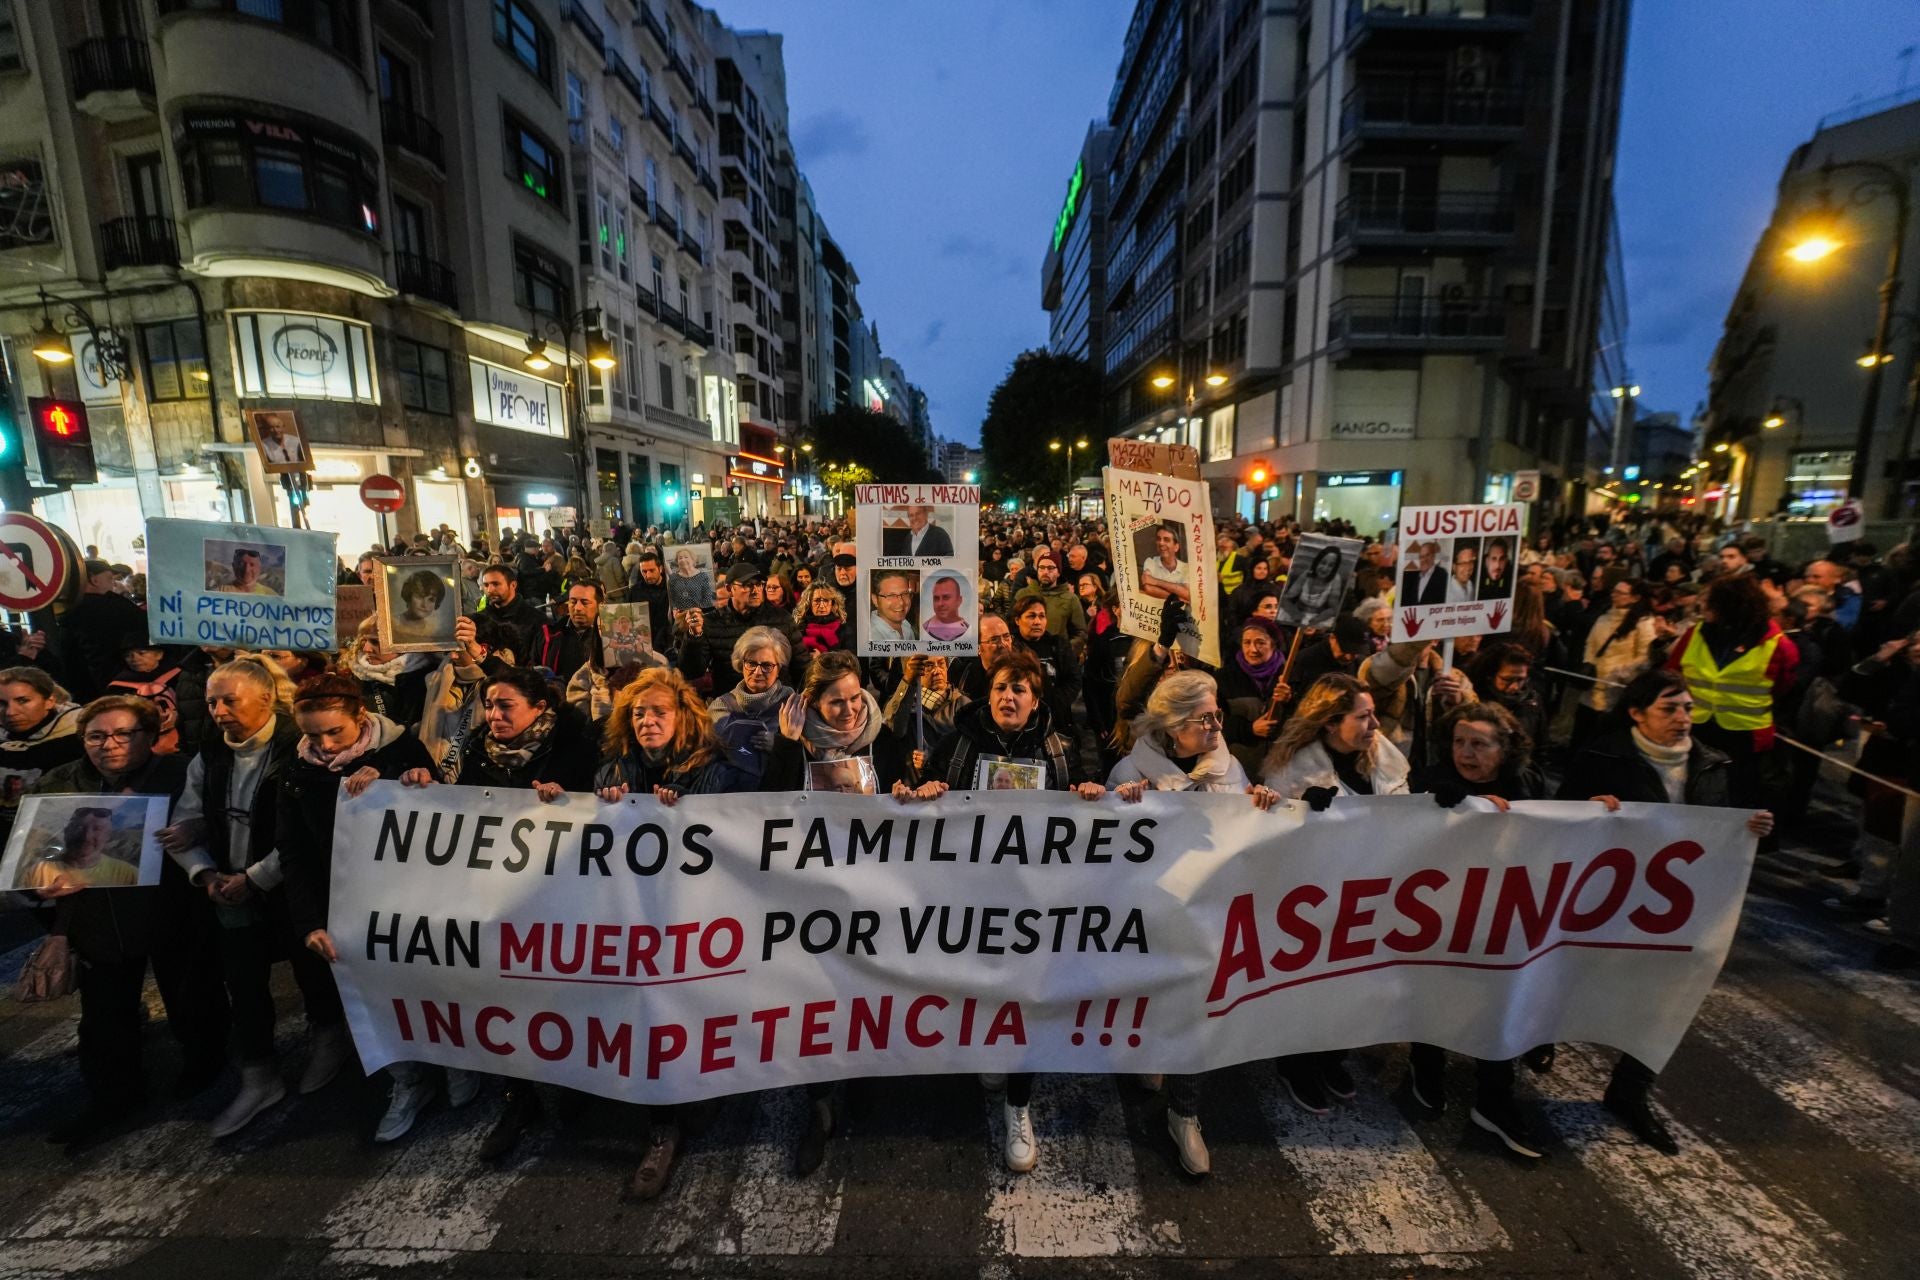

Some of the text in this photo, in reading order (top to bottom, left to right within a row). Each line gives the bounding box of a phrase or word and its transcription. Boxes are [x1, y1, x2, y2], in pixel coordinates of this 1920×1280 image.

[492, 372, 518, 393] Inmo
[500, 393, 546, 427] PEOPLE
[915, 486, 926, 504] de
[1120, 480, 1191, 508] MATADO
[1406, 508, 1519, 536] JUSTICIA
[921, 558, 942, 567] MORA
[198, 596, 334, 626] PERDONAMOS
[1429, 607, 1443, 616] por
[1456, 602, 1485, 612] marido
[1457, 616, 1476, 626] hijos
[895, 641, 917, 652] MORA
[955, 642, 973, 651] MORA
[374, 809, 1158, 877] NUESTROS FAMILIARES
[1206, 840, 1706, 1003] ASESINOS
[366, 905, 1149, 978] HAN MUERTO POR VUESTRA
[392, 995, 1149, 1080] INCOMPETENCIA !!!
